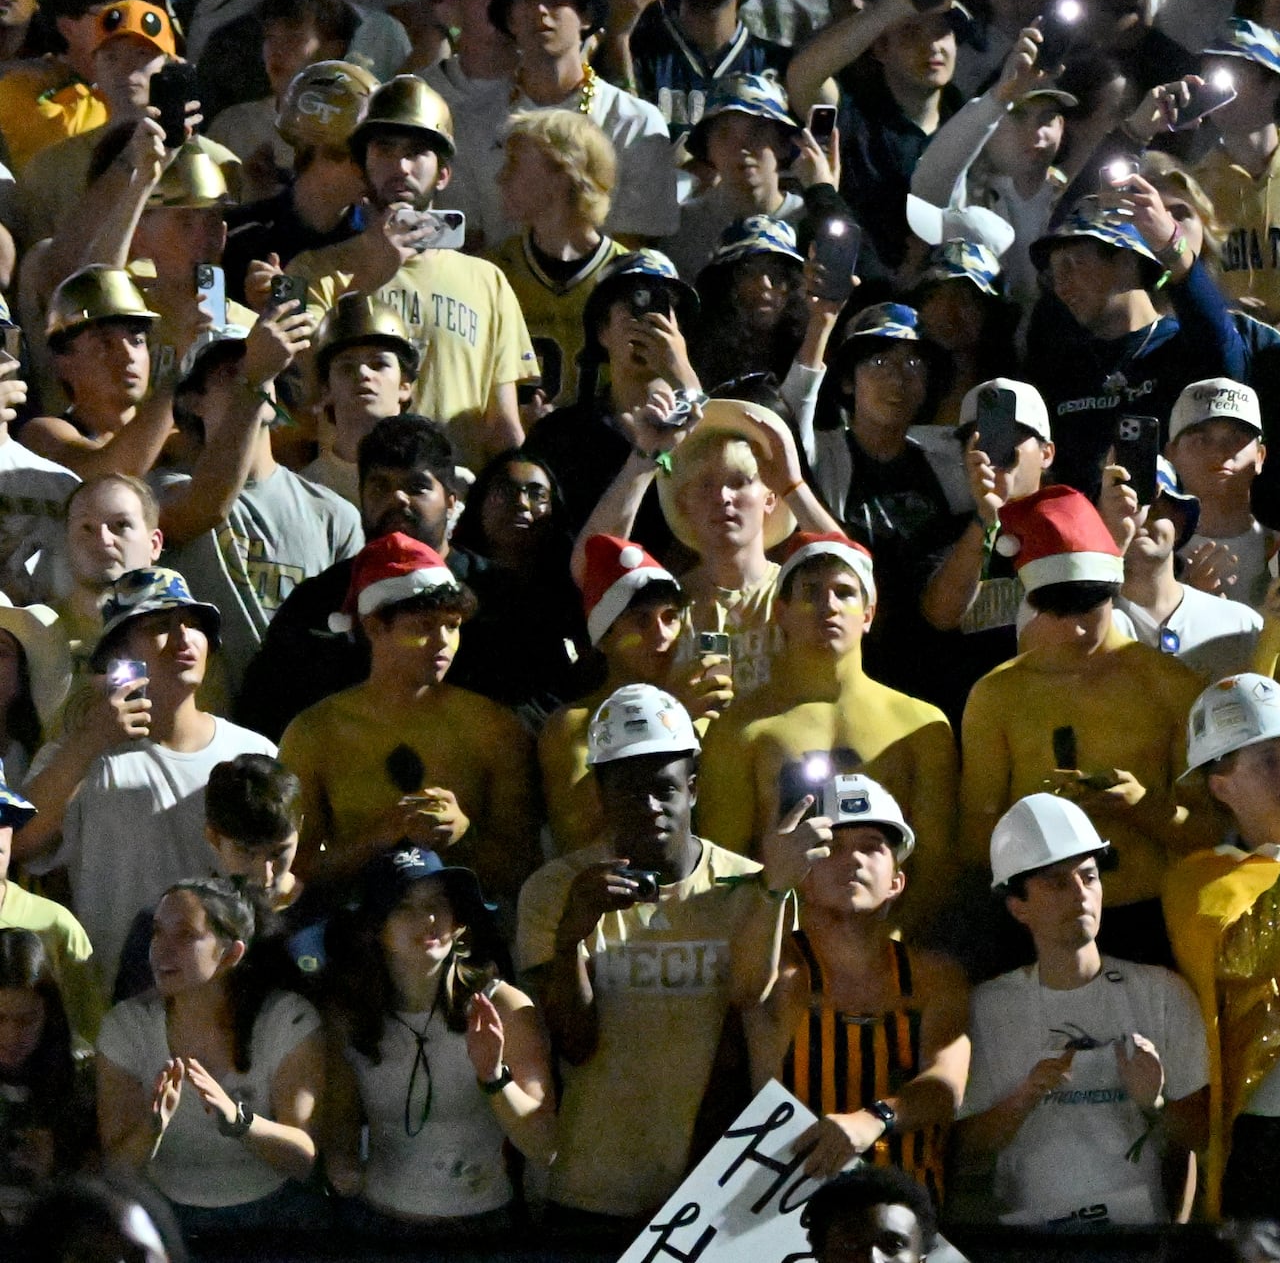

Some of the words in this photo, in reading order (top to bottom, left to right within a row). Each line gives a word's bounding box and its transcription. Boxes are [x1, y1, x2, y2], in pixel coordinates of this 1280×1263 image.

[431, 293, 478, 346] TECH
[1194, 388, 1250, 403] Georgia
[1205, 399, 1240, 412] Tech
